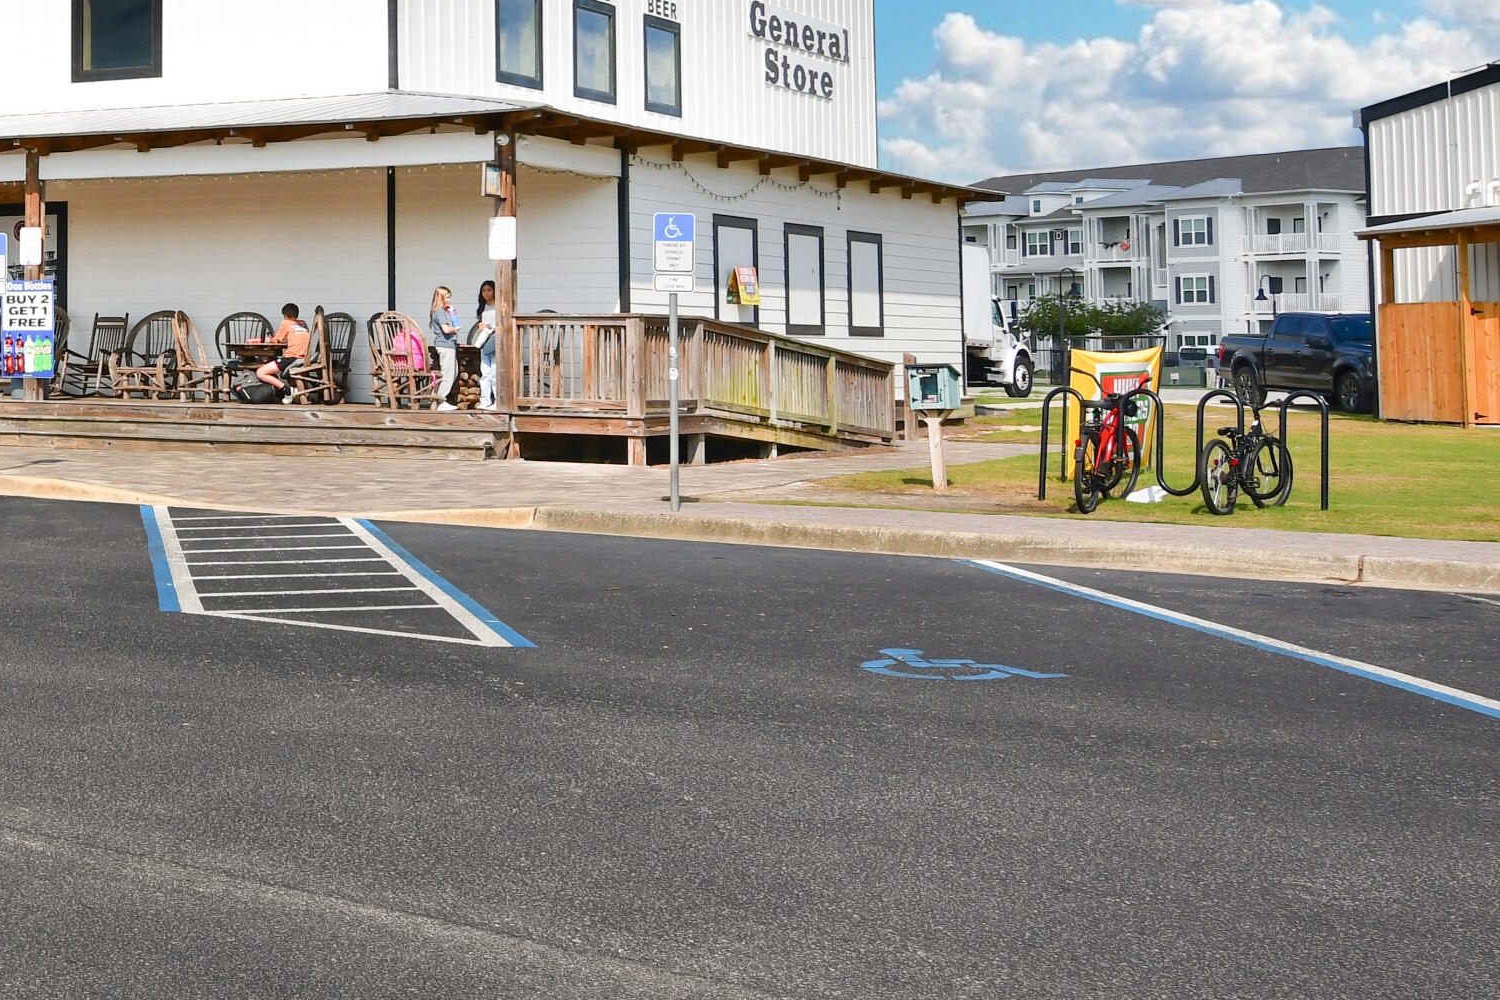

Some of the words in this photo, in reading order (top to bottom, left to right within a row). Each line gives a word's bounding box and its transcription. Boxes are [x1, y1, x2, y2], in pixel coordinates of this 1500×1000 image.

[749, 0, 849, 63] General
[765, 47, 833, 98] Store
[6, 281, 23, 291] 0oz
[6, 295, 37, 304] BUY
[41, 295, 49, 304] 2
[8, 306, 38, 315] GET
[43, 306, 48, 315] 1
[8, 318, 47, 327] FREE
